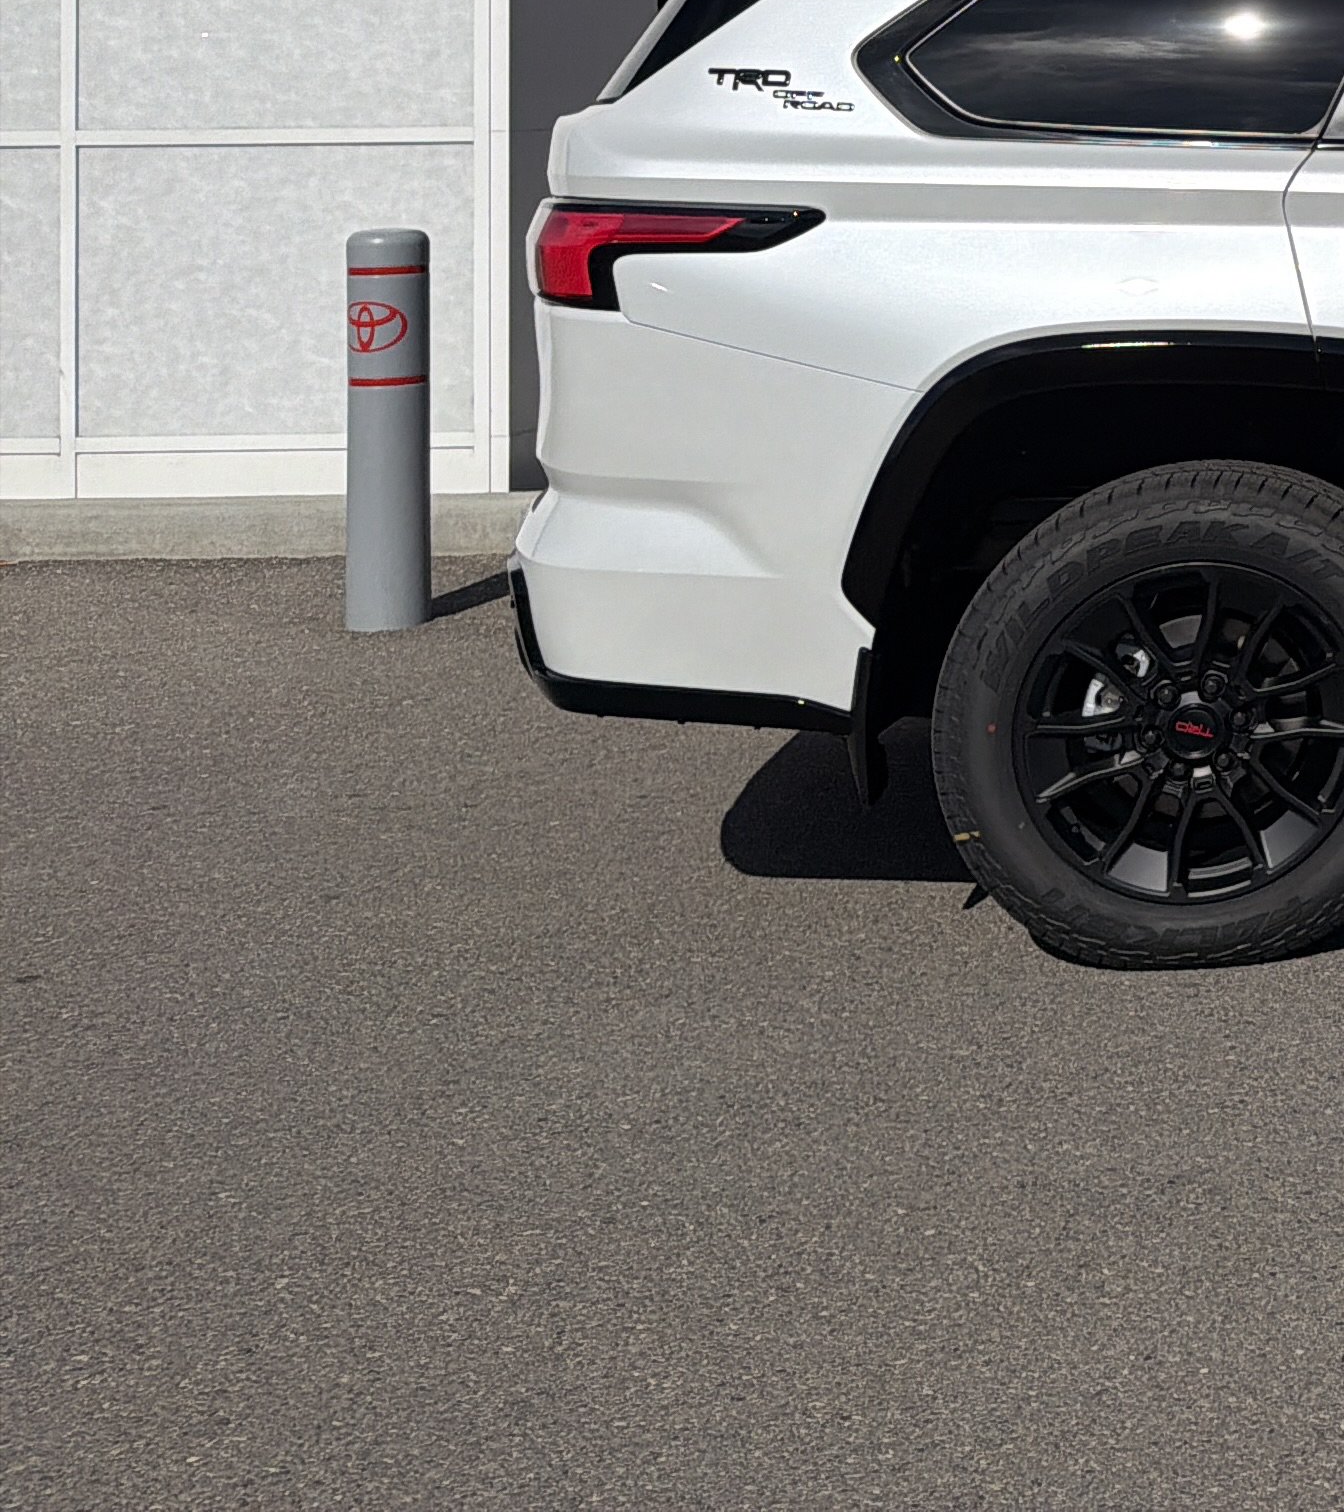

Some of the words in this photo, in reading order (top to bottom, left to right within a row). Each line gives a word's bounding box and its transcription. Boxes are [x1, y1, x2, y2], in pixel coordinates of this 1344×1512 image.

[708, 67, 792, 92] TRD
[772, 89, 825, 100] OFF
[782, 99, 856, 112] ROAD
[1175, 720, 1214, 738] TRD
